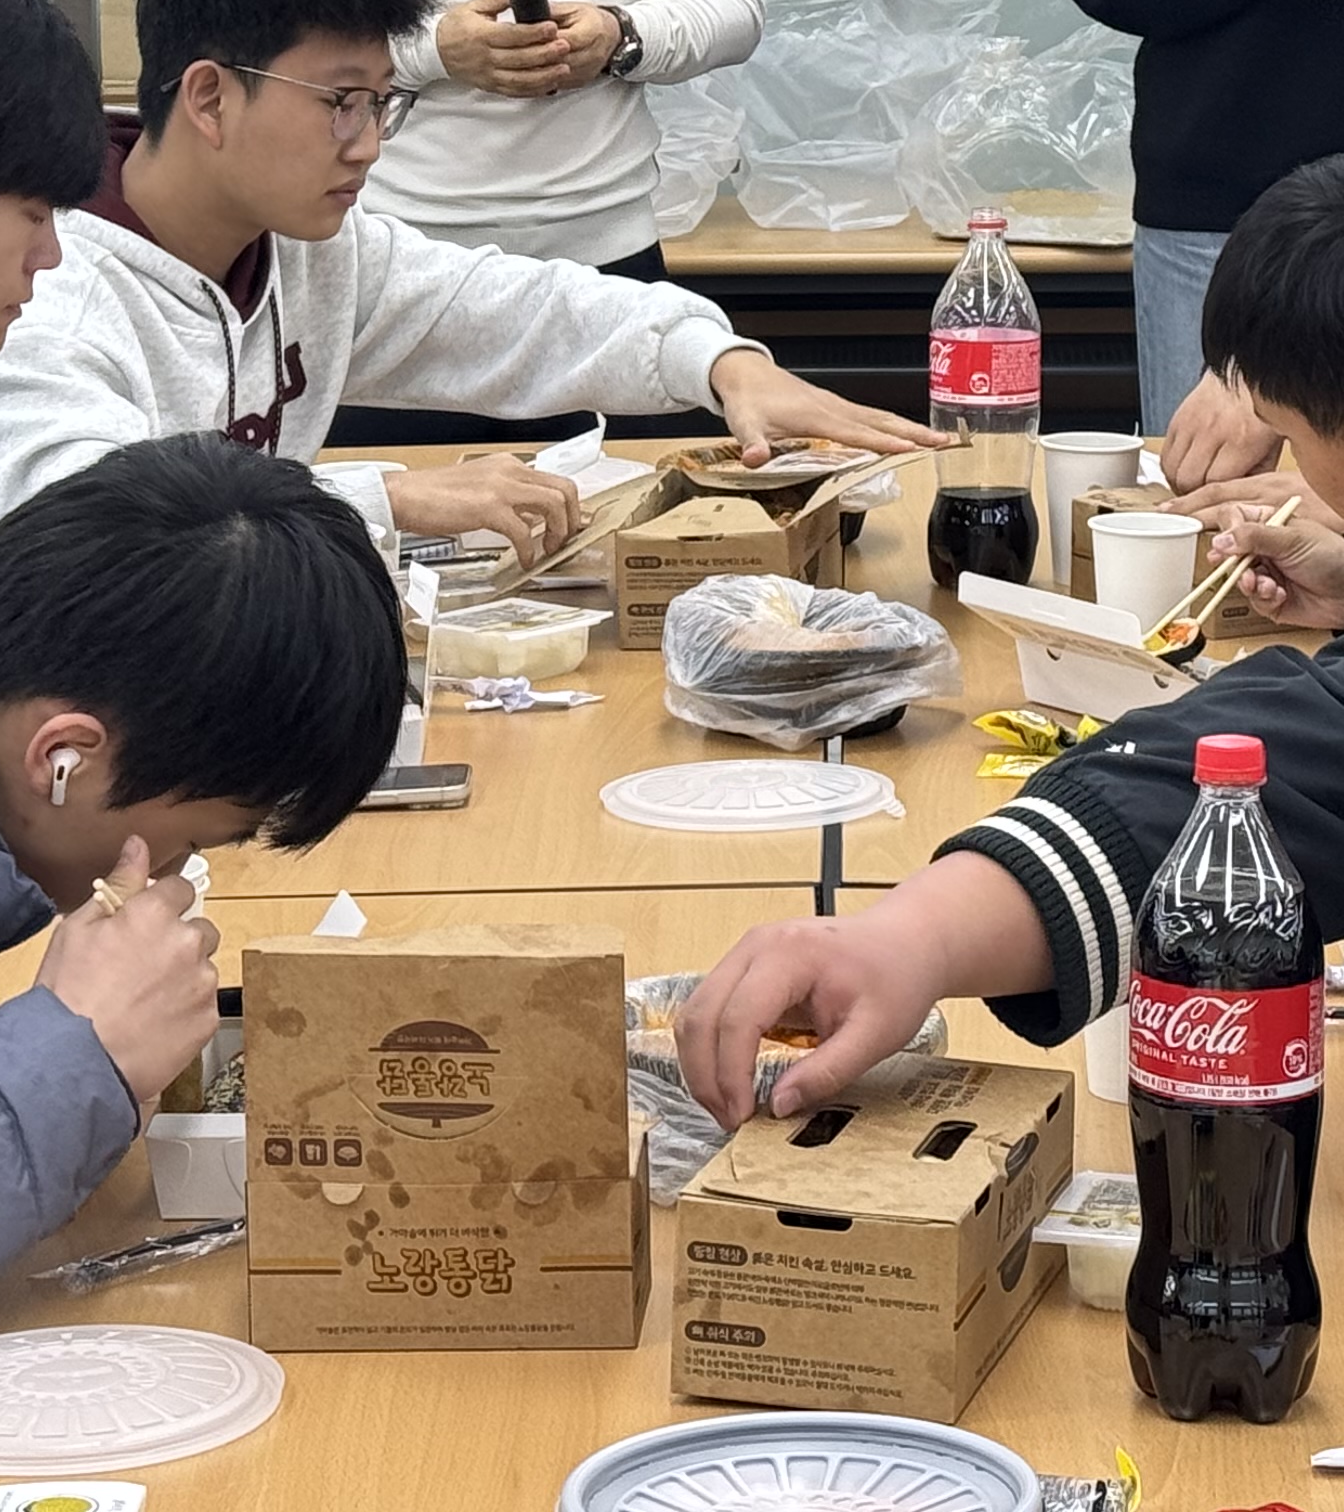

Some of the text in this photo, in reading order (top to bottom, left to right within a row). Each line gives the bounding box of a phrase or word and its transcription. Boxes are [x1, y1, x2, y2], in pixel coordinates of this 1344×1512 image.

[1181, 1054, 1229, 1070] TASTE
[377, 1056, 495, 1099] 노랑통닭
[366, 1246, 516, 1299] 노랑통닭
[830, 1259, 876, 1275] 안심하고
